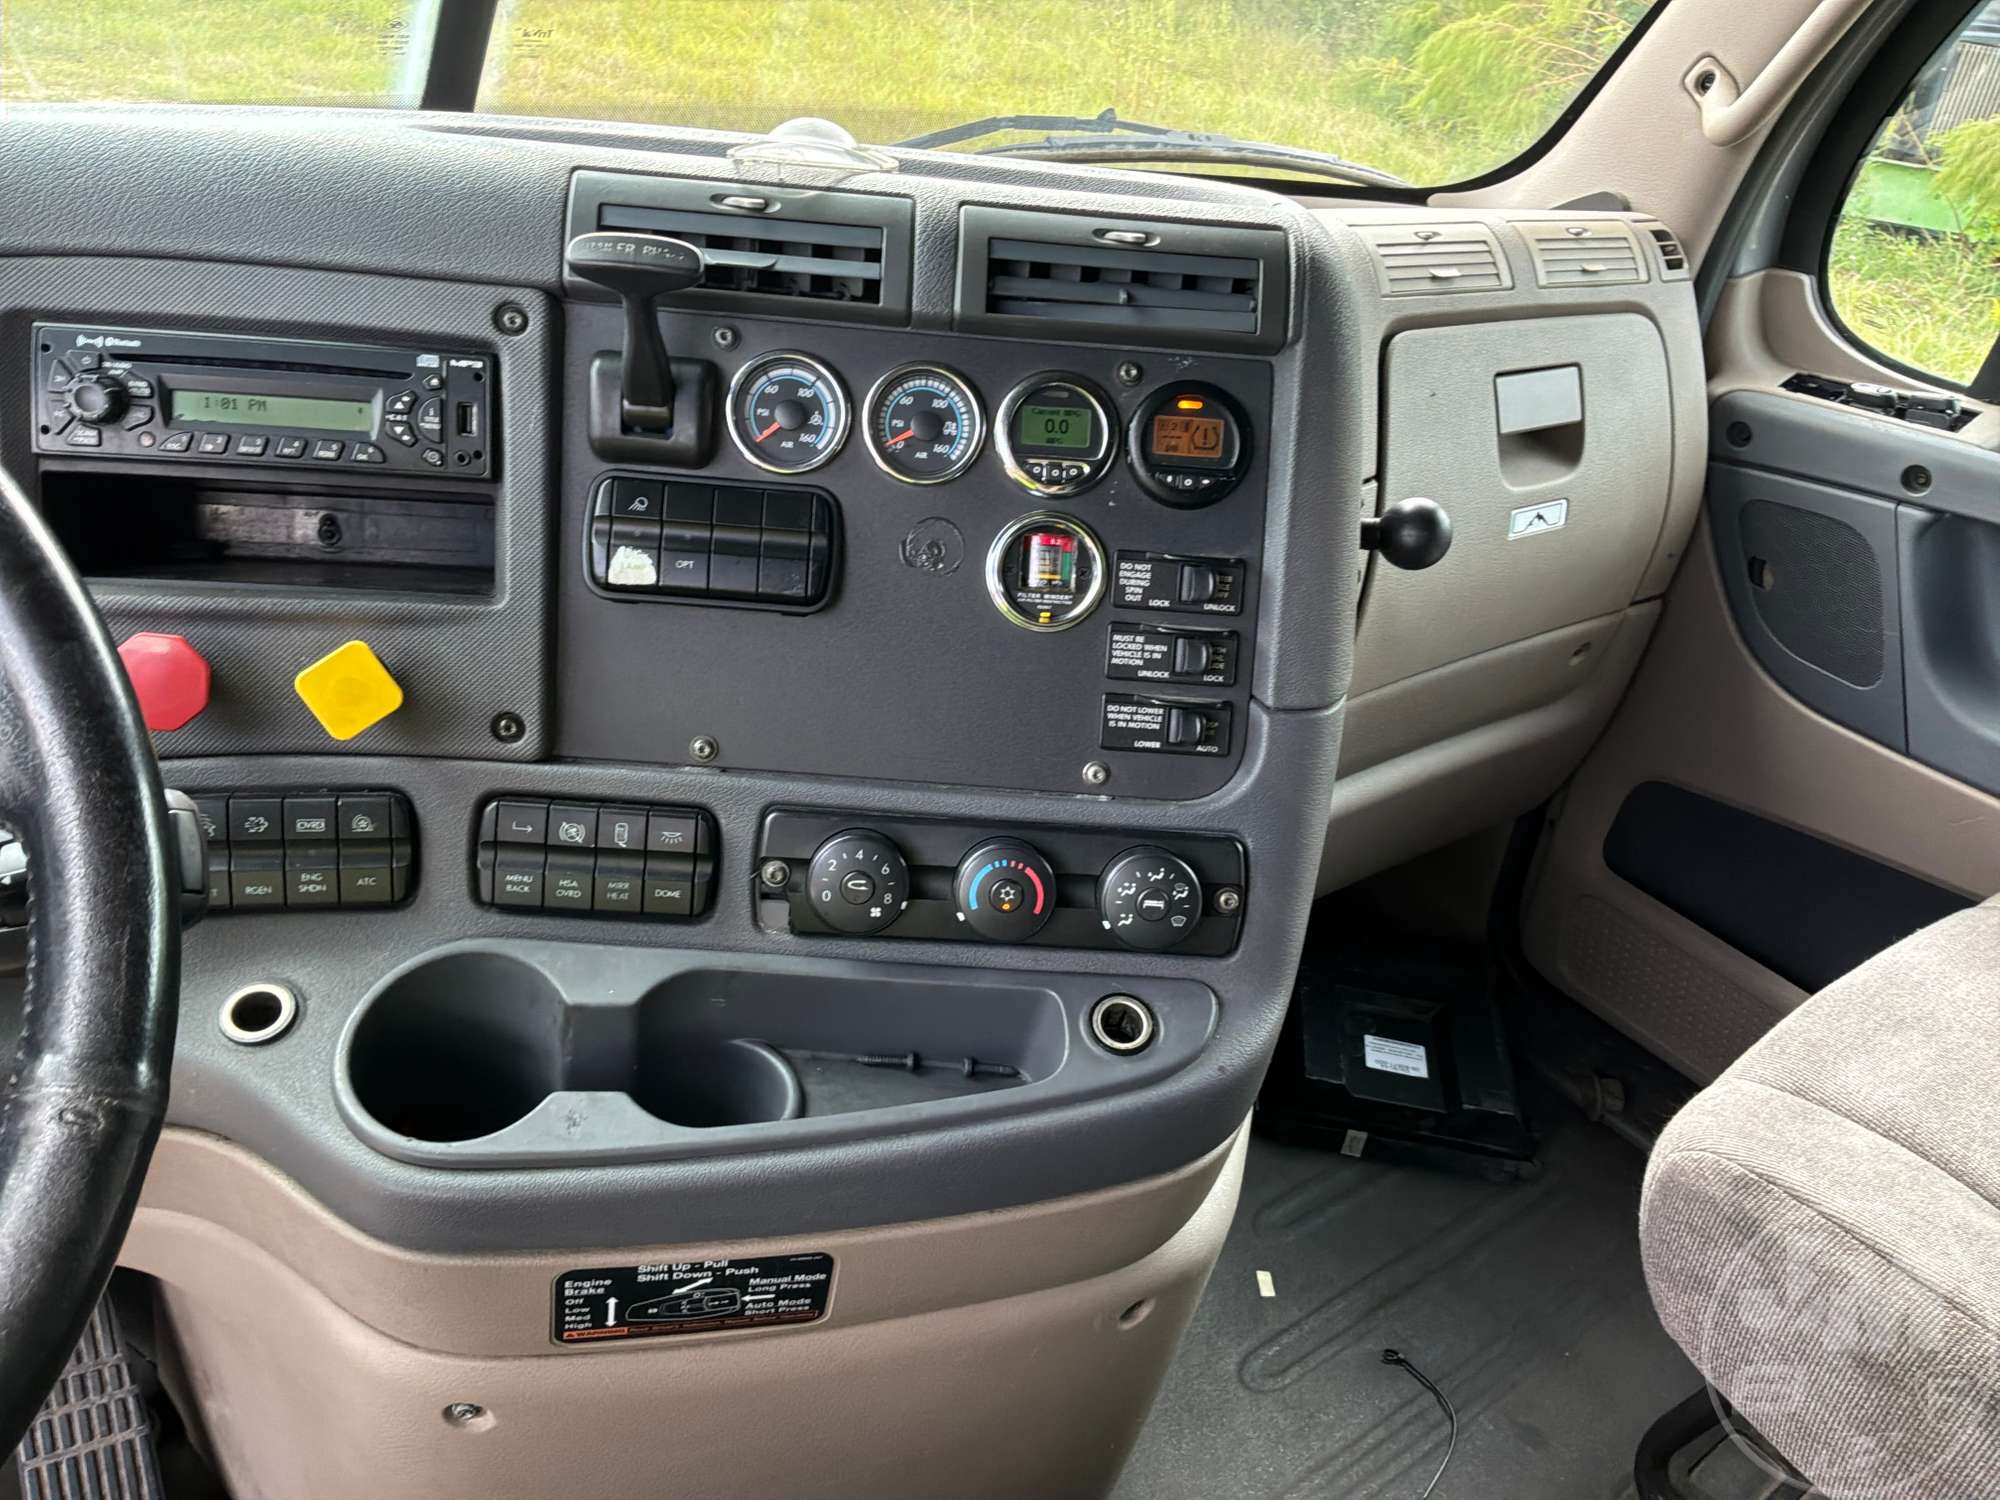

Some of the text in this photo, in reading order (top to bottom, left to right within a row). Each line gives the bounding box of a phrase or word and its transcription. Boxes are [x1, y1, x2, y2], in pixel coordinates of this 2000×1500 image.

[450, 359, 484, 369] MP3
[764, 385, 779, 394] 60
[797, 387, 814, 399] 100
[204, 397, 268, 412] 1:01 PM
[899, 396, 913, 405] 60
[932, 399, 948, 409] 100
[757, 408, 769, 416] PSI
[892, 419, 904, 427] PSI
[1045, 418, 1069, 434] 0.0
[799, 432, 817, 444] 160
[780, 440, 794, 449] AIR
[933, 443, 949, 454] 160
[675, 560, 695, 569] OPT
[1120, 562, 1152, 571] DO NOT
[1119, 570, 1152, 579] ENGAGE
[1119, 578, 1151, 587] DURING
[1124, 594, 1142, 602] OUT
[1148, 599, 1170, 607] LOCK
[1203, 603, 1236, 612] UNLOCK
[1113, 634, 1134, 642] MUST
[1112, 642, 1168, 652] LOCKED WHEN
[1111, 650, 1142, 658] VEHICLE
[1143, 651, 1151, 659] IS
[1111, 657, 1143, 666] MOTION
[1137, 670, 1170, 678] UNLOCK
[1203, 674, 1225, 682] LOCK
[1107, 704, 1164, 715] DO NOT LOWER
[1107, 713, 1163, 723] WHEN VEHICLE
[1127, 722, 1160, 730] MOTION
[1134, 740, 1161, 748] LOWER
[1196, 745, 1219, 753] AUTO
[855, 848, 864, 861] 4
[827, 859, 837, 872] 2
[881, 863, 890, 875] 6
[301, 872, 324, 882] ENG
[356, 876, 377, 886] ATC
[504, 874, 533, 883] MENU
[298, 883, 327, 893] SHDN
[559, 879, 579, 888] HSA
[506, 884, 531, 893] BACK
[556, 889, 581, 898] OVRD
[606, 891, 629, 900] HEAT
[654, 889, 681, 898] DOME
[822, 891, 832, 902] 0
[883, 892, 892, 905] 8
[637, 1264, 668, 1273] Shift
[672, 1263, 691, 1272] Up
[703, 1260, 729, 1269] Pull
[637, 1272, 668, 1282] Shift
[672, 1271, 712, 1280] Down
[725, 1267, 760, 1276] Push
[564, 1279, 613, 1289] Engine
[749, 1273, 827, 1286] Manual Mode
[748, 1282, 811, 1292] Long Press
[564, 1287, 605, 1297] Brake
[565, 1298, 585, 1306] Off
[745, 1298, 812, 1310] Auto Mode
[744, 1305, 811, 1316] Short Press
[565, 1314, 591, 1322] Med
[565, 1322, 593, 1330] High
